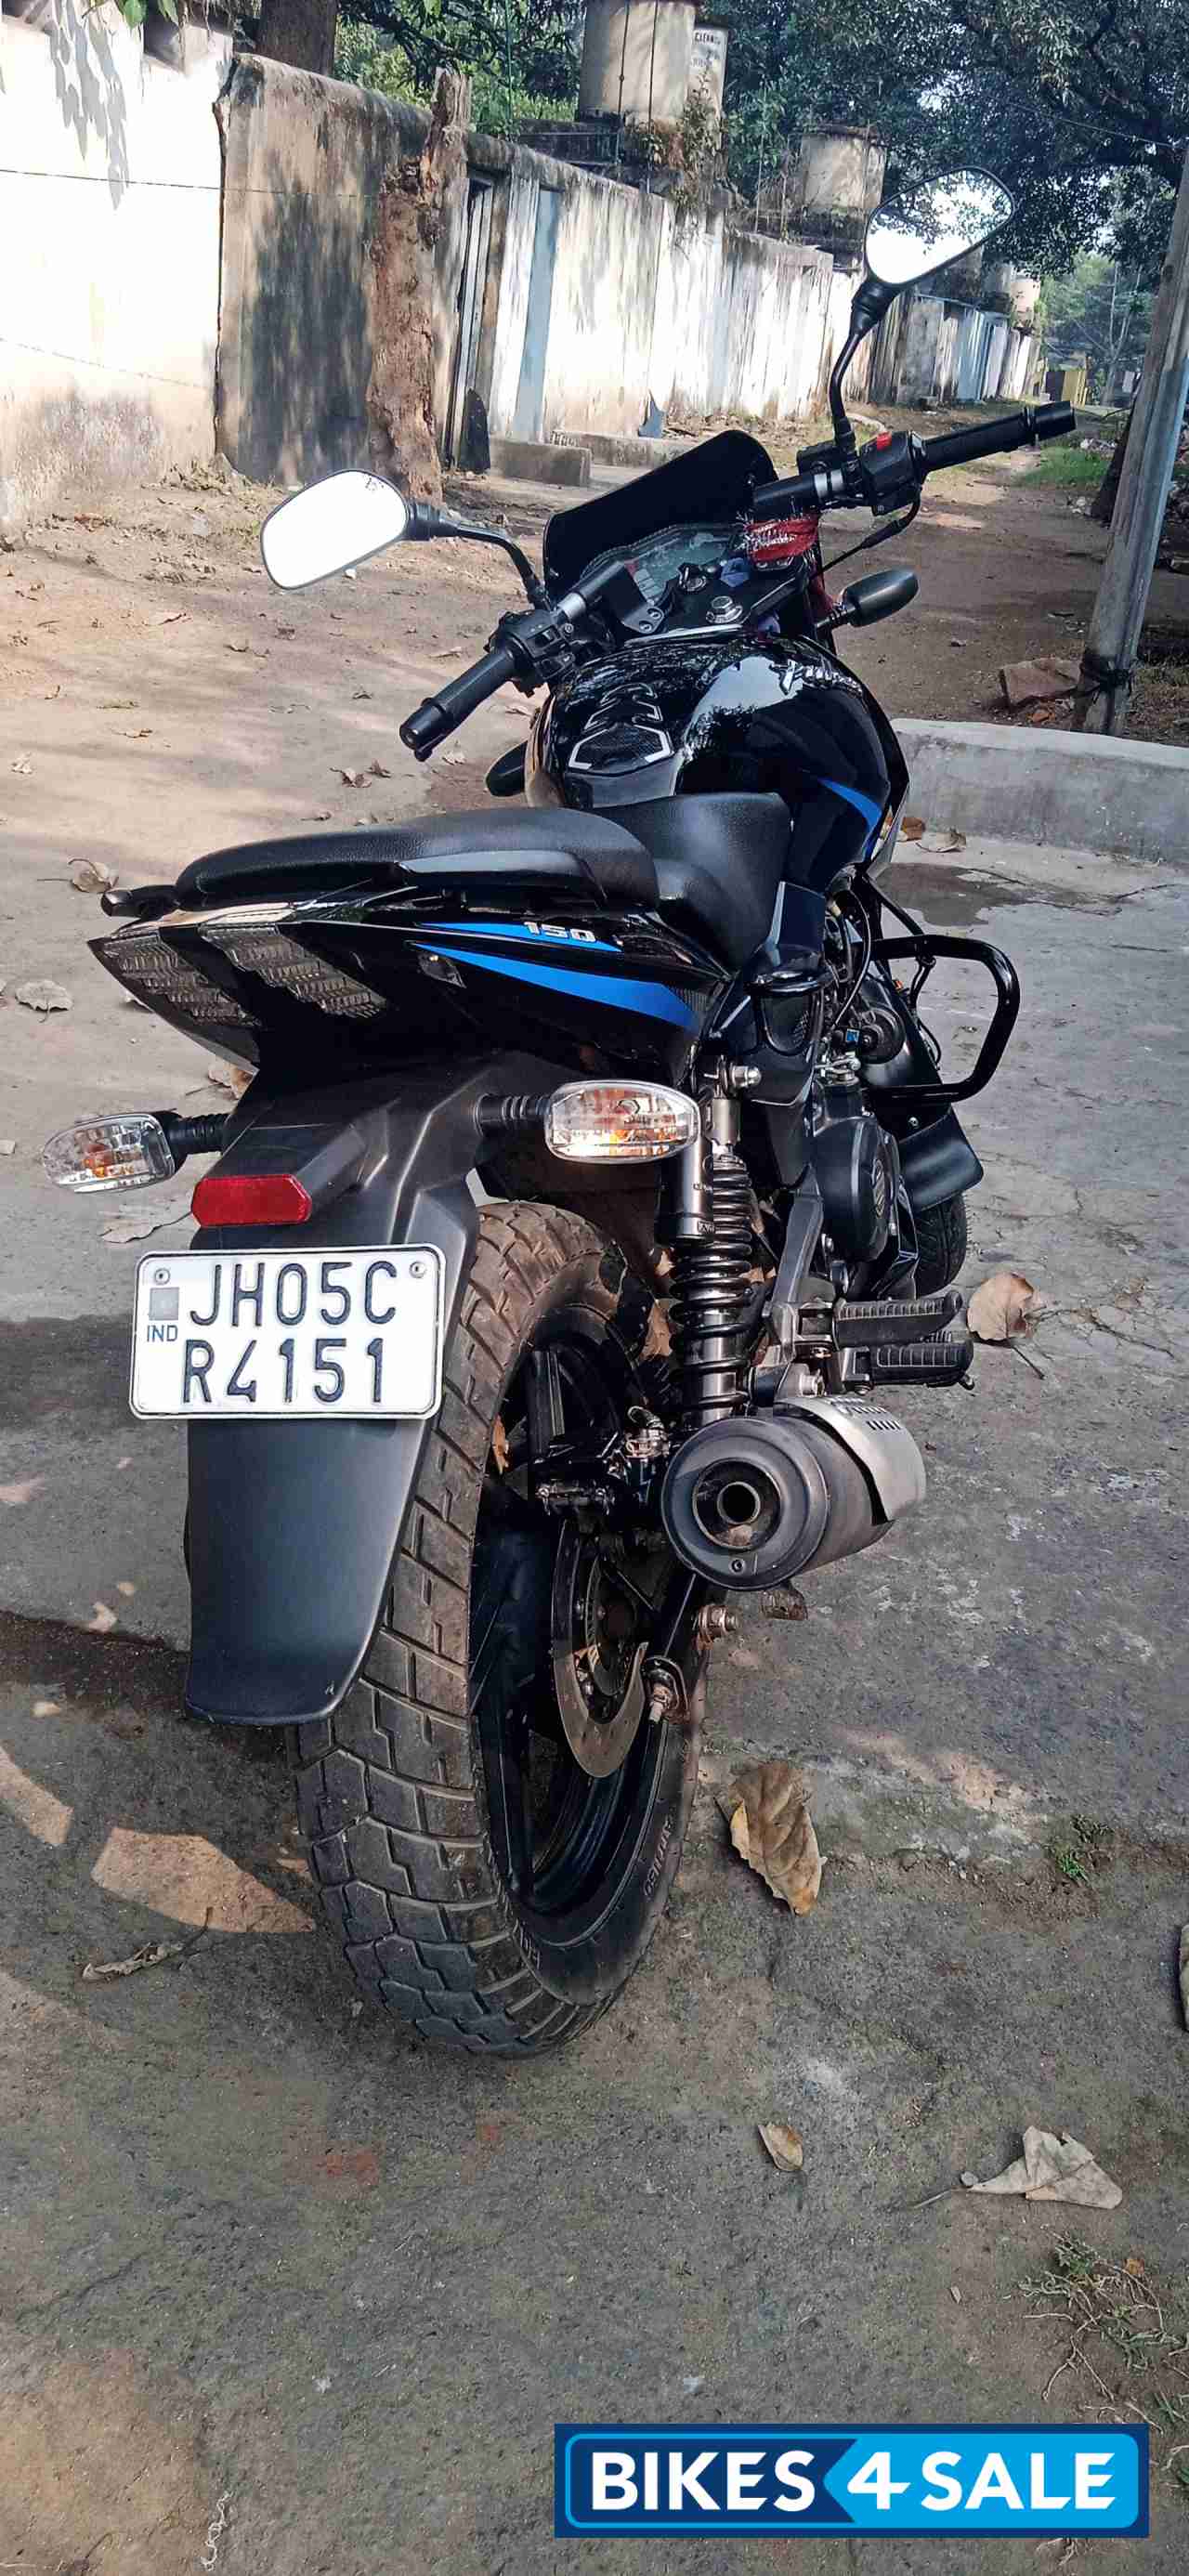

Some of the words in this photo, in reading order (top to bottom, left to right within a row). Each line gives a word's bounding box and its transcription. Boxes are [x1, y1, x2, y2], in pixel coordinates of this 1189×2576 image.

[524, 922, 596, 942] 150
[189, 1261, 398, 1327] JH05C
[147, 1325, 178, 1342] IND
[183, 1338, 383, 1403] R4151
